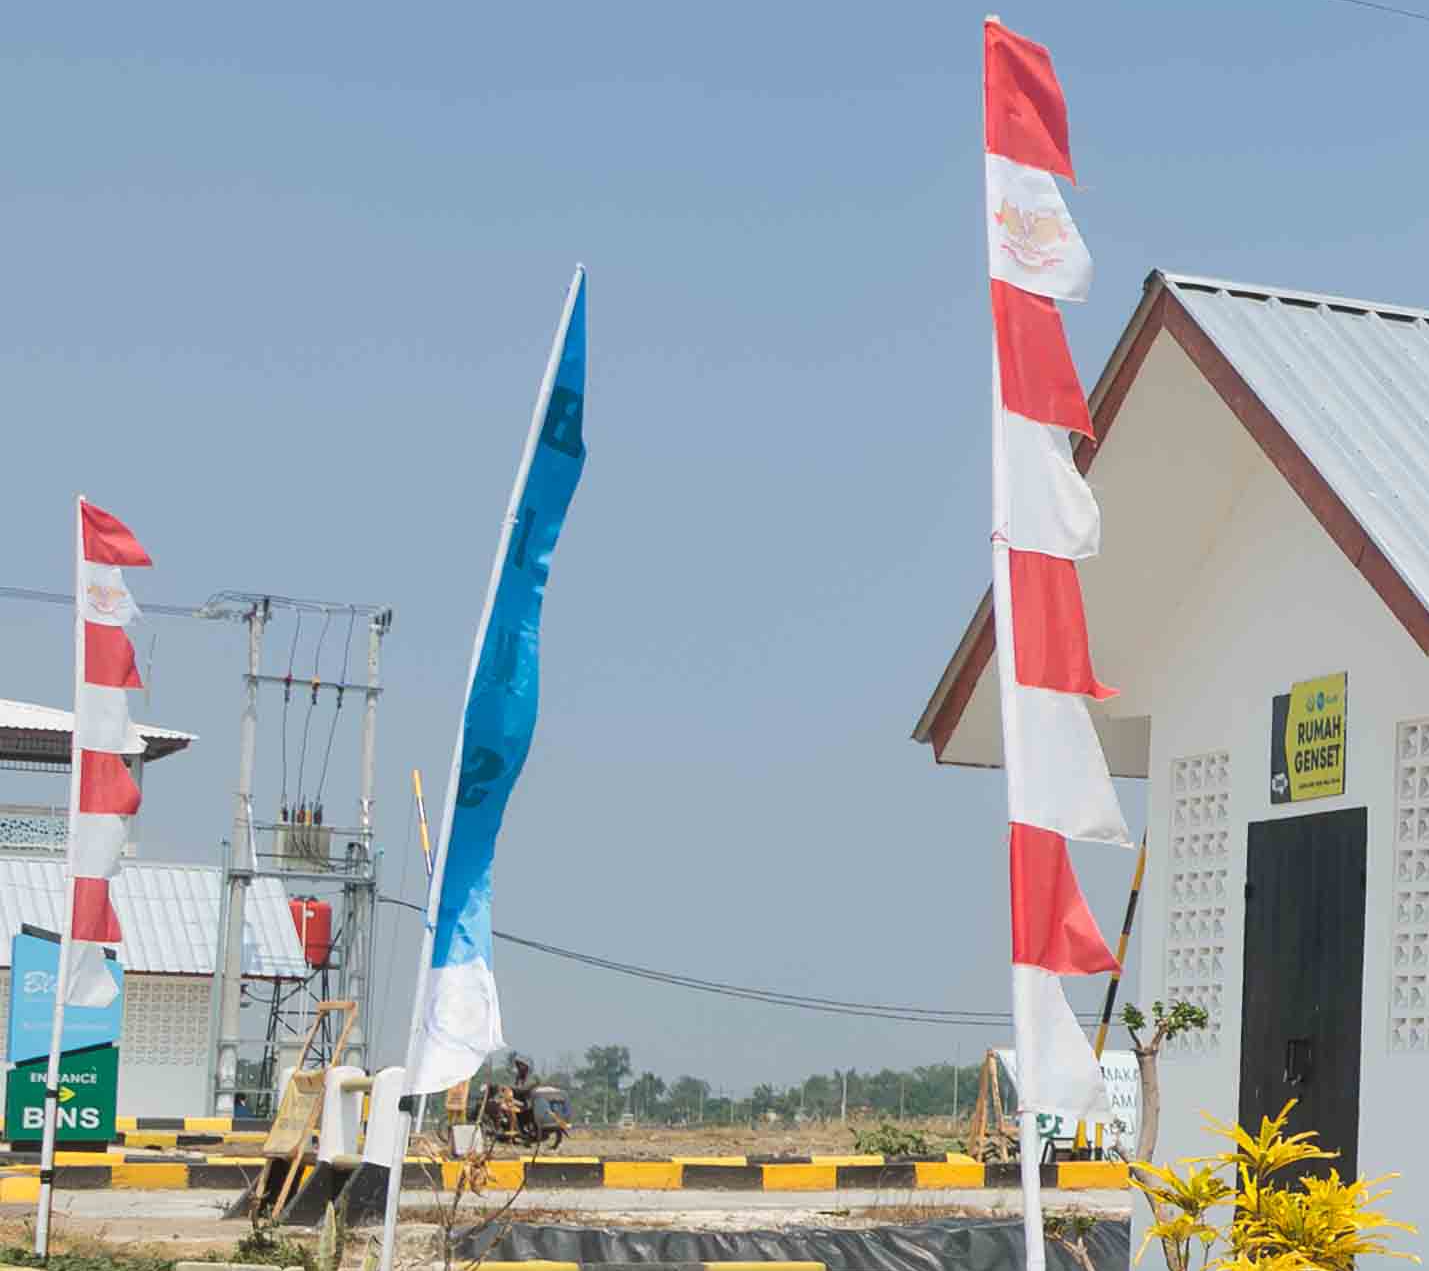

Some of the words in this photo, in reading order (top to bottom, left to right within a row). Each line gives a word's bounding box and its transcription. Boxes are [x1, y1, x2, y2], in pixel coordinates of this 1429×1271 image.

[1296, 715, 1341, 746] RUMAH
[1295, 743, 1341, 773] GENSET
[30, 1072, 97, 1084] ENANCE
[22, 1106, 101, 1129] BNS
